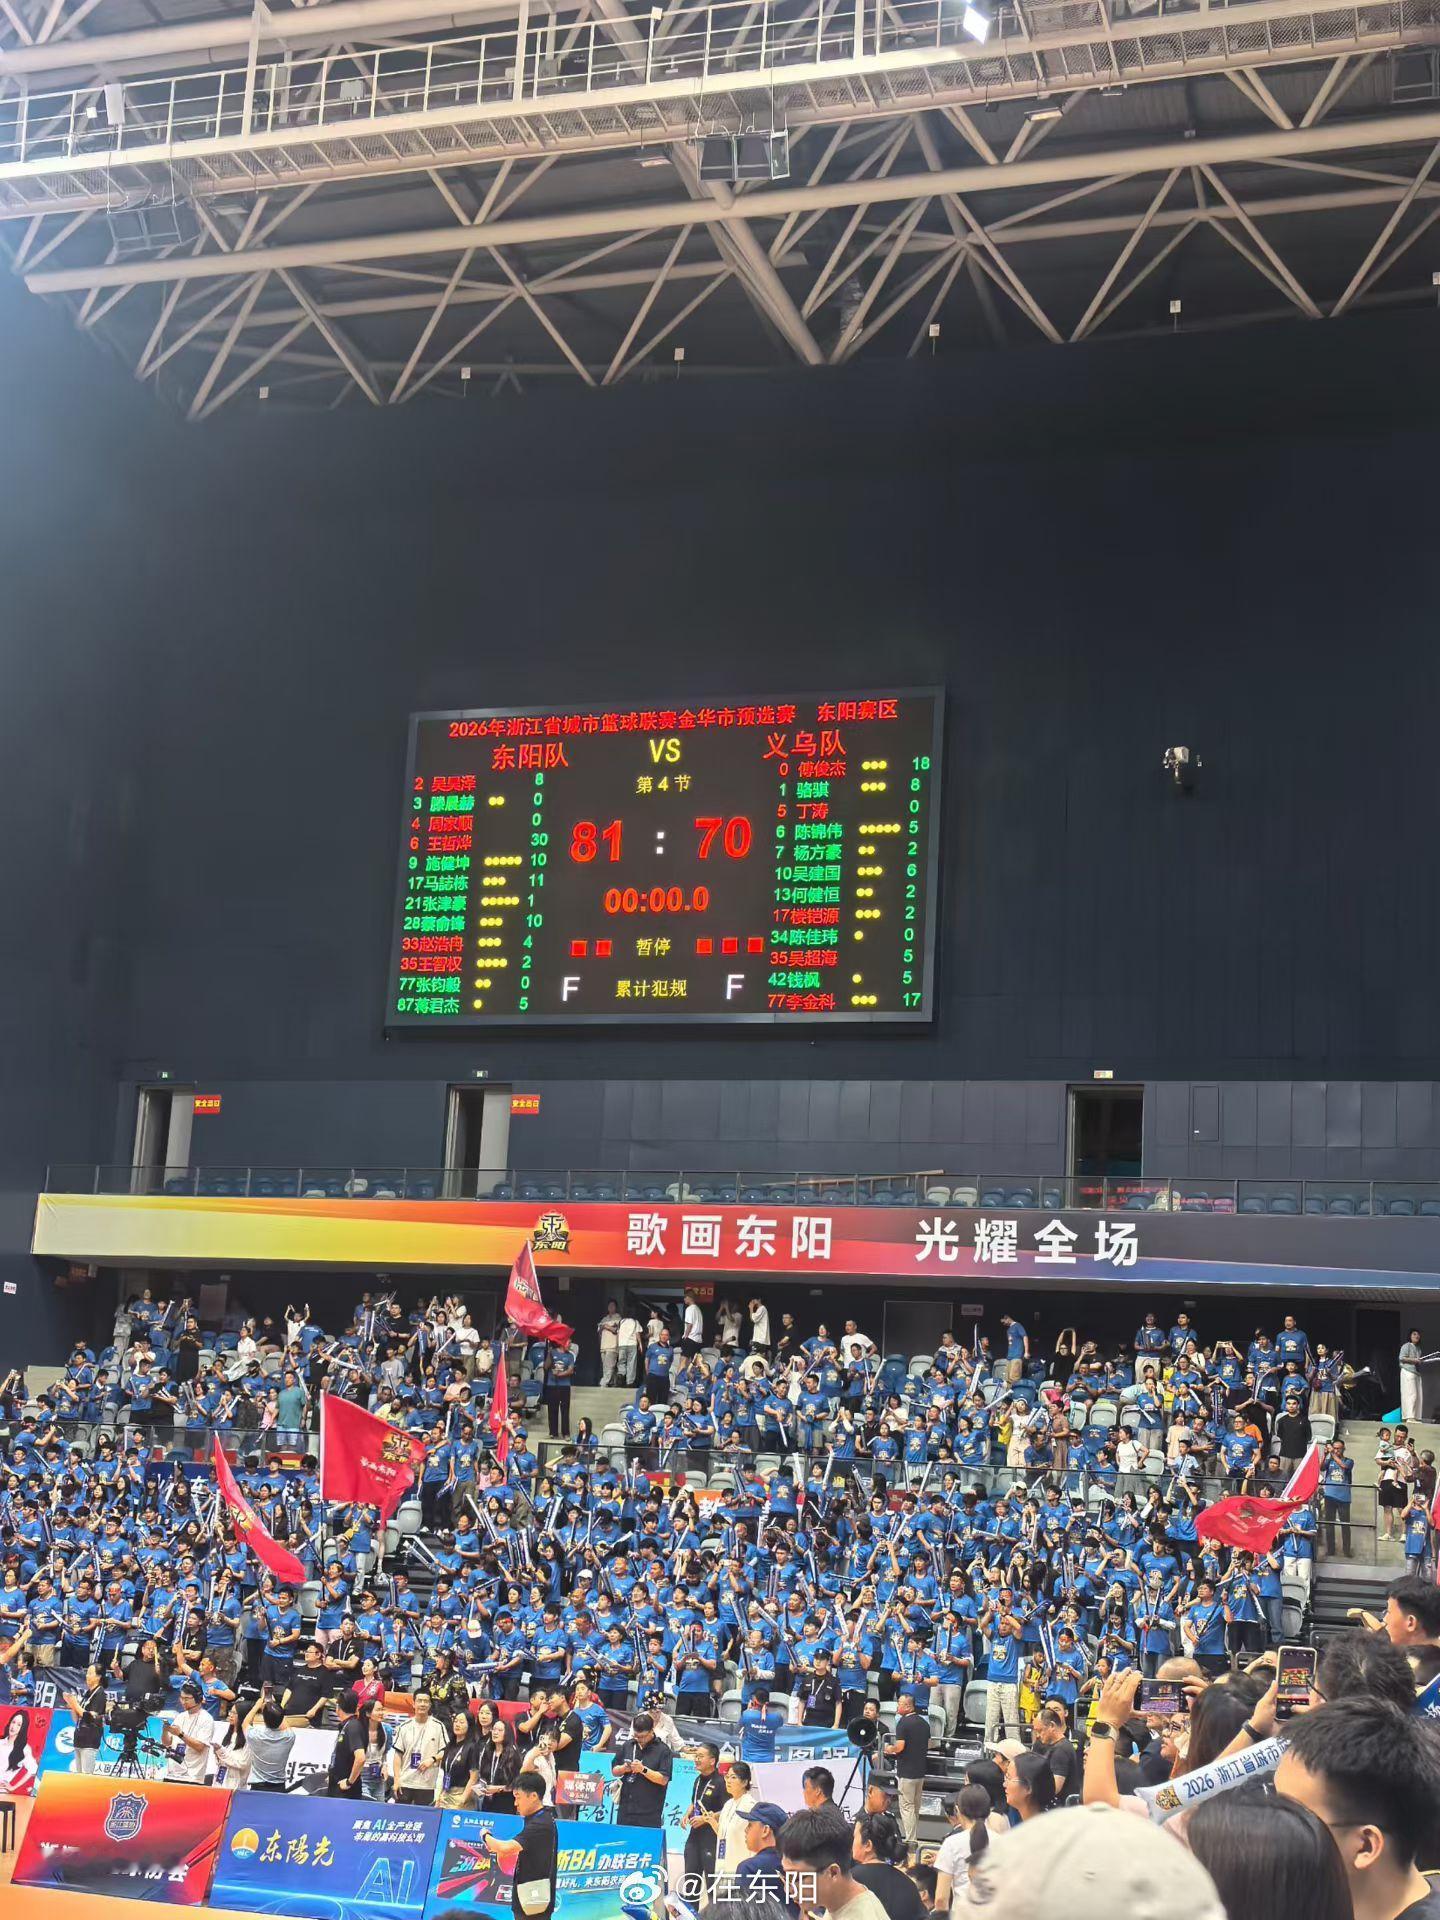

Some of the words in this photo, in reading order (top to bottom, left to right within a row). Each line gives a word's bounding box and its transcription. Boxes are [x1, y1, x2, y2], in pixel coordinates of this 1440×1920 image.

[448, 704, 797, 738] 2026年浙江省城市篮球联赛金华市预选赛
[817, 699, 899, 722] 东阳赛区
[649, 738, 680, 763] VS
[763, 729, 846, 760] 义乌队
[492, 742, 569, 772] 东阳队
[779, 761, 789, 776] 0
[798, 760, 847, 778] 傅俊杰
[913, 756, 931, 771] 18
[413, 776, 424, 791] 2
[535, 773, 544, 786] 8
[779, 783, 787, 796] 1
[911, 778, 920, 792] 8
[413, 796, 423, 810] 3
[534, 793, 543, 806] 0
[777, 804, 787, 818] 5
[796, 803, 829, 820] 丁涛
[910, 799, 919, 813] 0
[411, 816, 421, 830] 4
[429, 815, 474, 833] 周家顺
[532, 813, 542, 827] 0
[776, 825, 785, 839] 6
[795, 823, 843, 840] 陈锦伟
[909, 820, 919, 835] 5
[410, 836, 419, 851] 6
[531, 833, 549, 847] 30
[571, 820, 623, 863] 81
[694, 816, 753, 860] 70
[776, 846, 784, 860] 7
[793, 844, 843, 861] 杨方豪
[908, 842, 918, 856] 2
[408, 856, 418, 870] 9
[531, 853, 547, 867] 10
[907, 864, 917, 877] 6
[530, 873, 543, 888] 11
[604, 886, 710, 915] 00:00.0
[906, 884, 916, 899] 2
[528, 894, 534, 908] 1
[526, 914, 542, 928] 10
[905, 905, 915, 920] 2
[523, 935, 533, 949] 4
[904, 927, 914, 942] 0
[636, 938, 671, 957] 暂停
[903, 949, 913, 963] 5
[522, 955, 532, 969] 2
[521, 976, 530, 990] 0
[903, 970, 912, 985] 5
[562, 977, 581, 1001] F
[615, 978, 687, 998] 累计犯规
[726, 974, 745, 999] F
[519, 997, 529, 1010] 5
[903, 992, 921, 1007] 17
[627, 1213, 833, 1260] 歌画东阳
[915, 1216, 1139, 1267] 光耀全场
[1183, 1773, 1215, 1798] 2026
[598, 1853, 653, 1870] 办联名卡
[354, 1858, 415, 1906] AI
